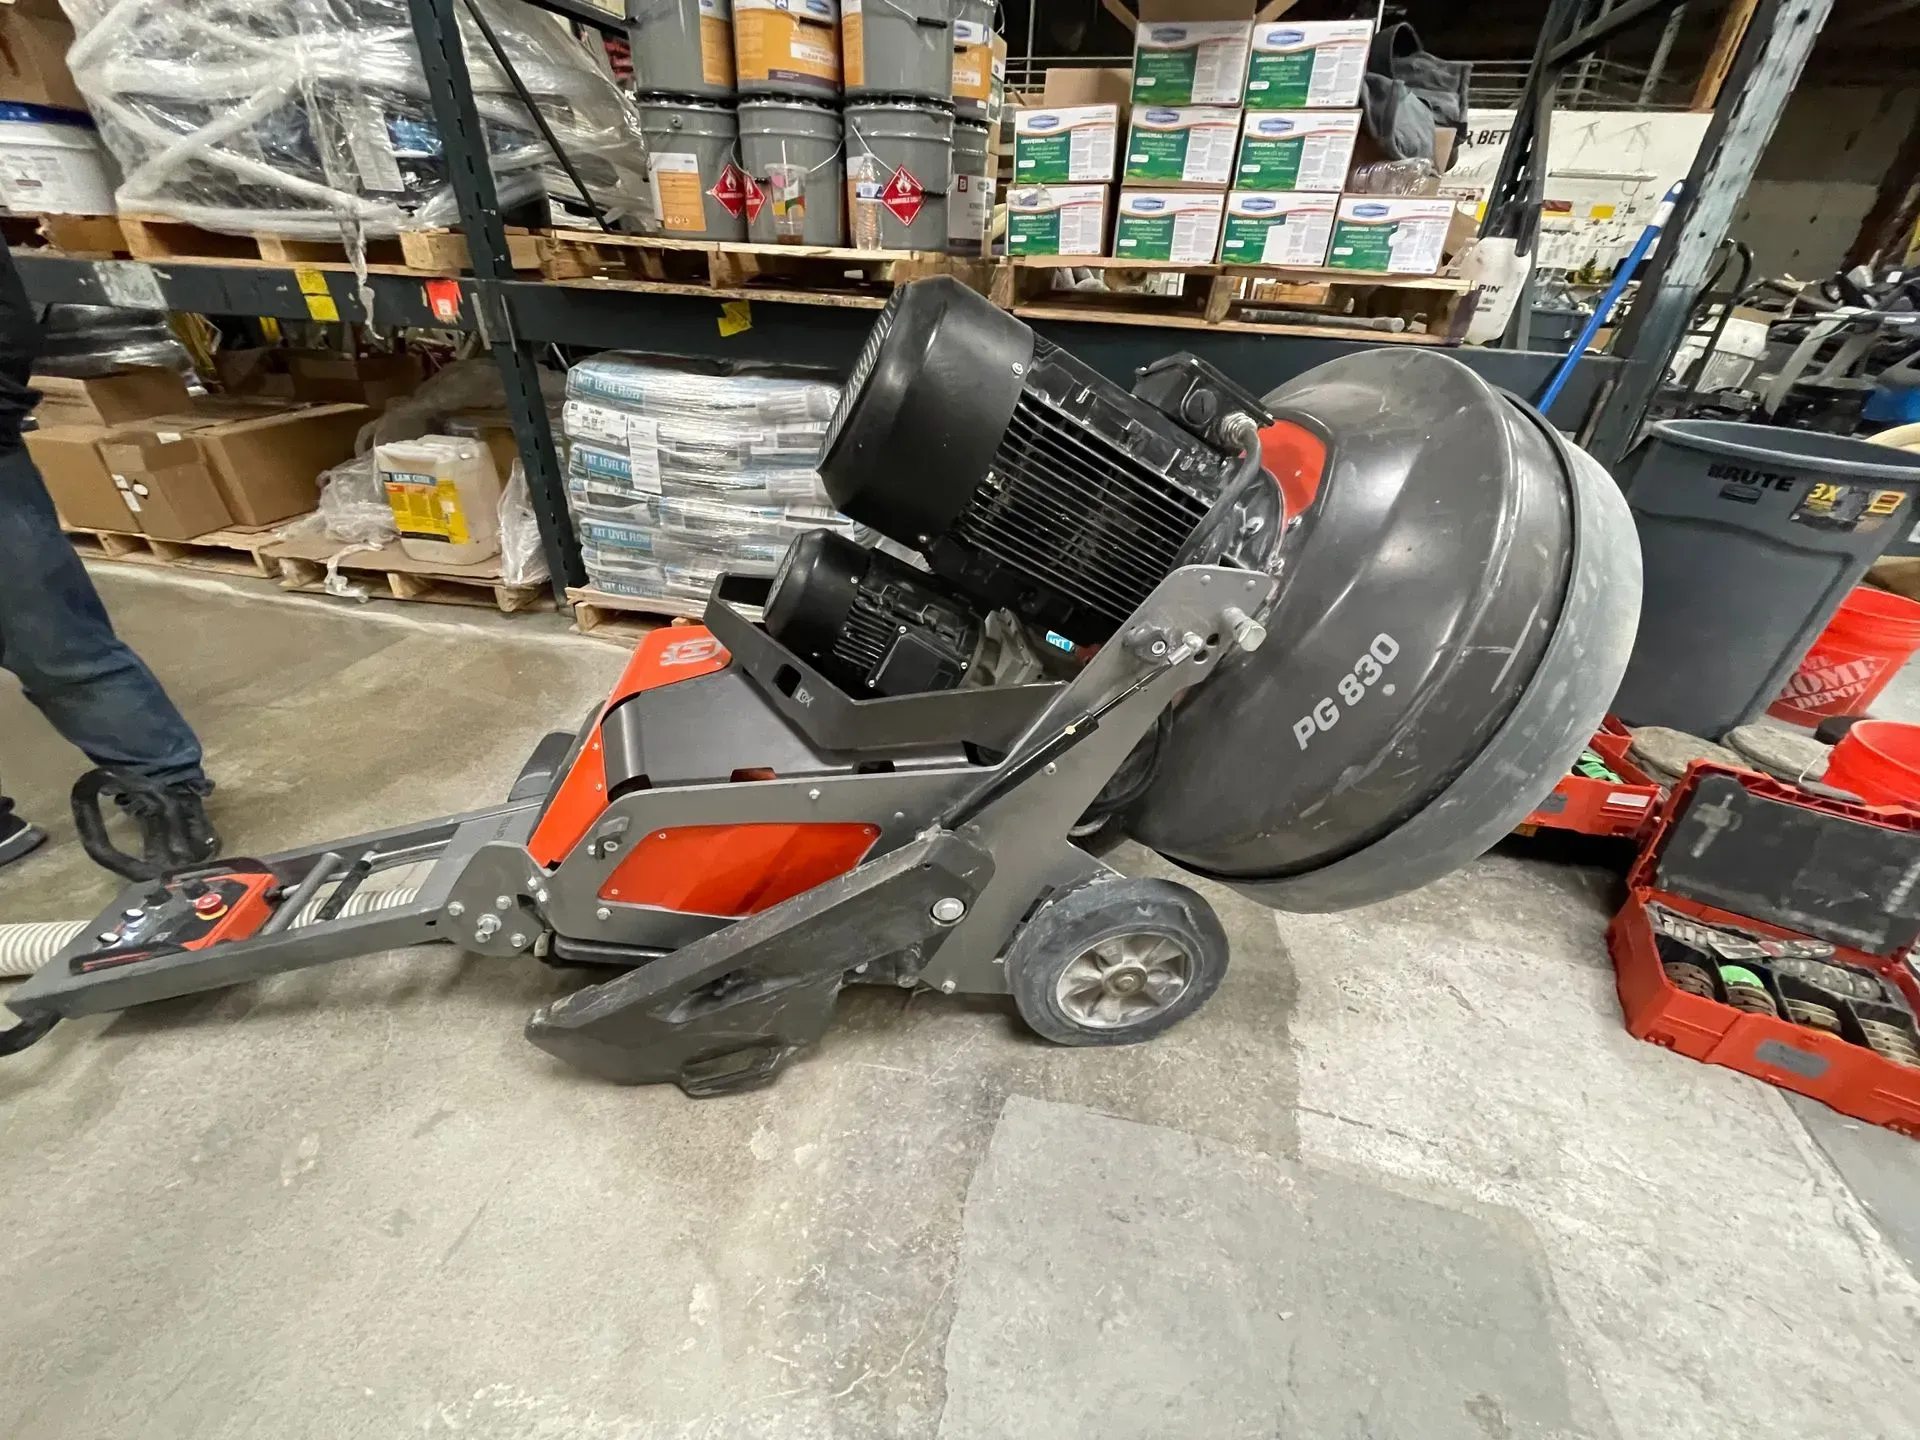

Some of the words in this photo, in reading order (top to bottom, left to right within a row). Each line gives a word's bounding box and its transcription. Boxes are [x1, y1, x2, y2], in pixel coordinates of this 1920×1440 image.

[904, 215, 909, 223] 3
[594, 380, 617, 394] LEVEL
[600, 455, 620, 470] LEVEL
[1707, 463, 1797, 493] BRUTE
[607, 528, 629, 540] LEVEL
[1292, 696, 1340, 751] PG
[1337, 632, 1400, 706] 830
[1794, 681, 1868, 710] DEPOT
